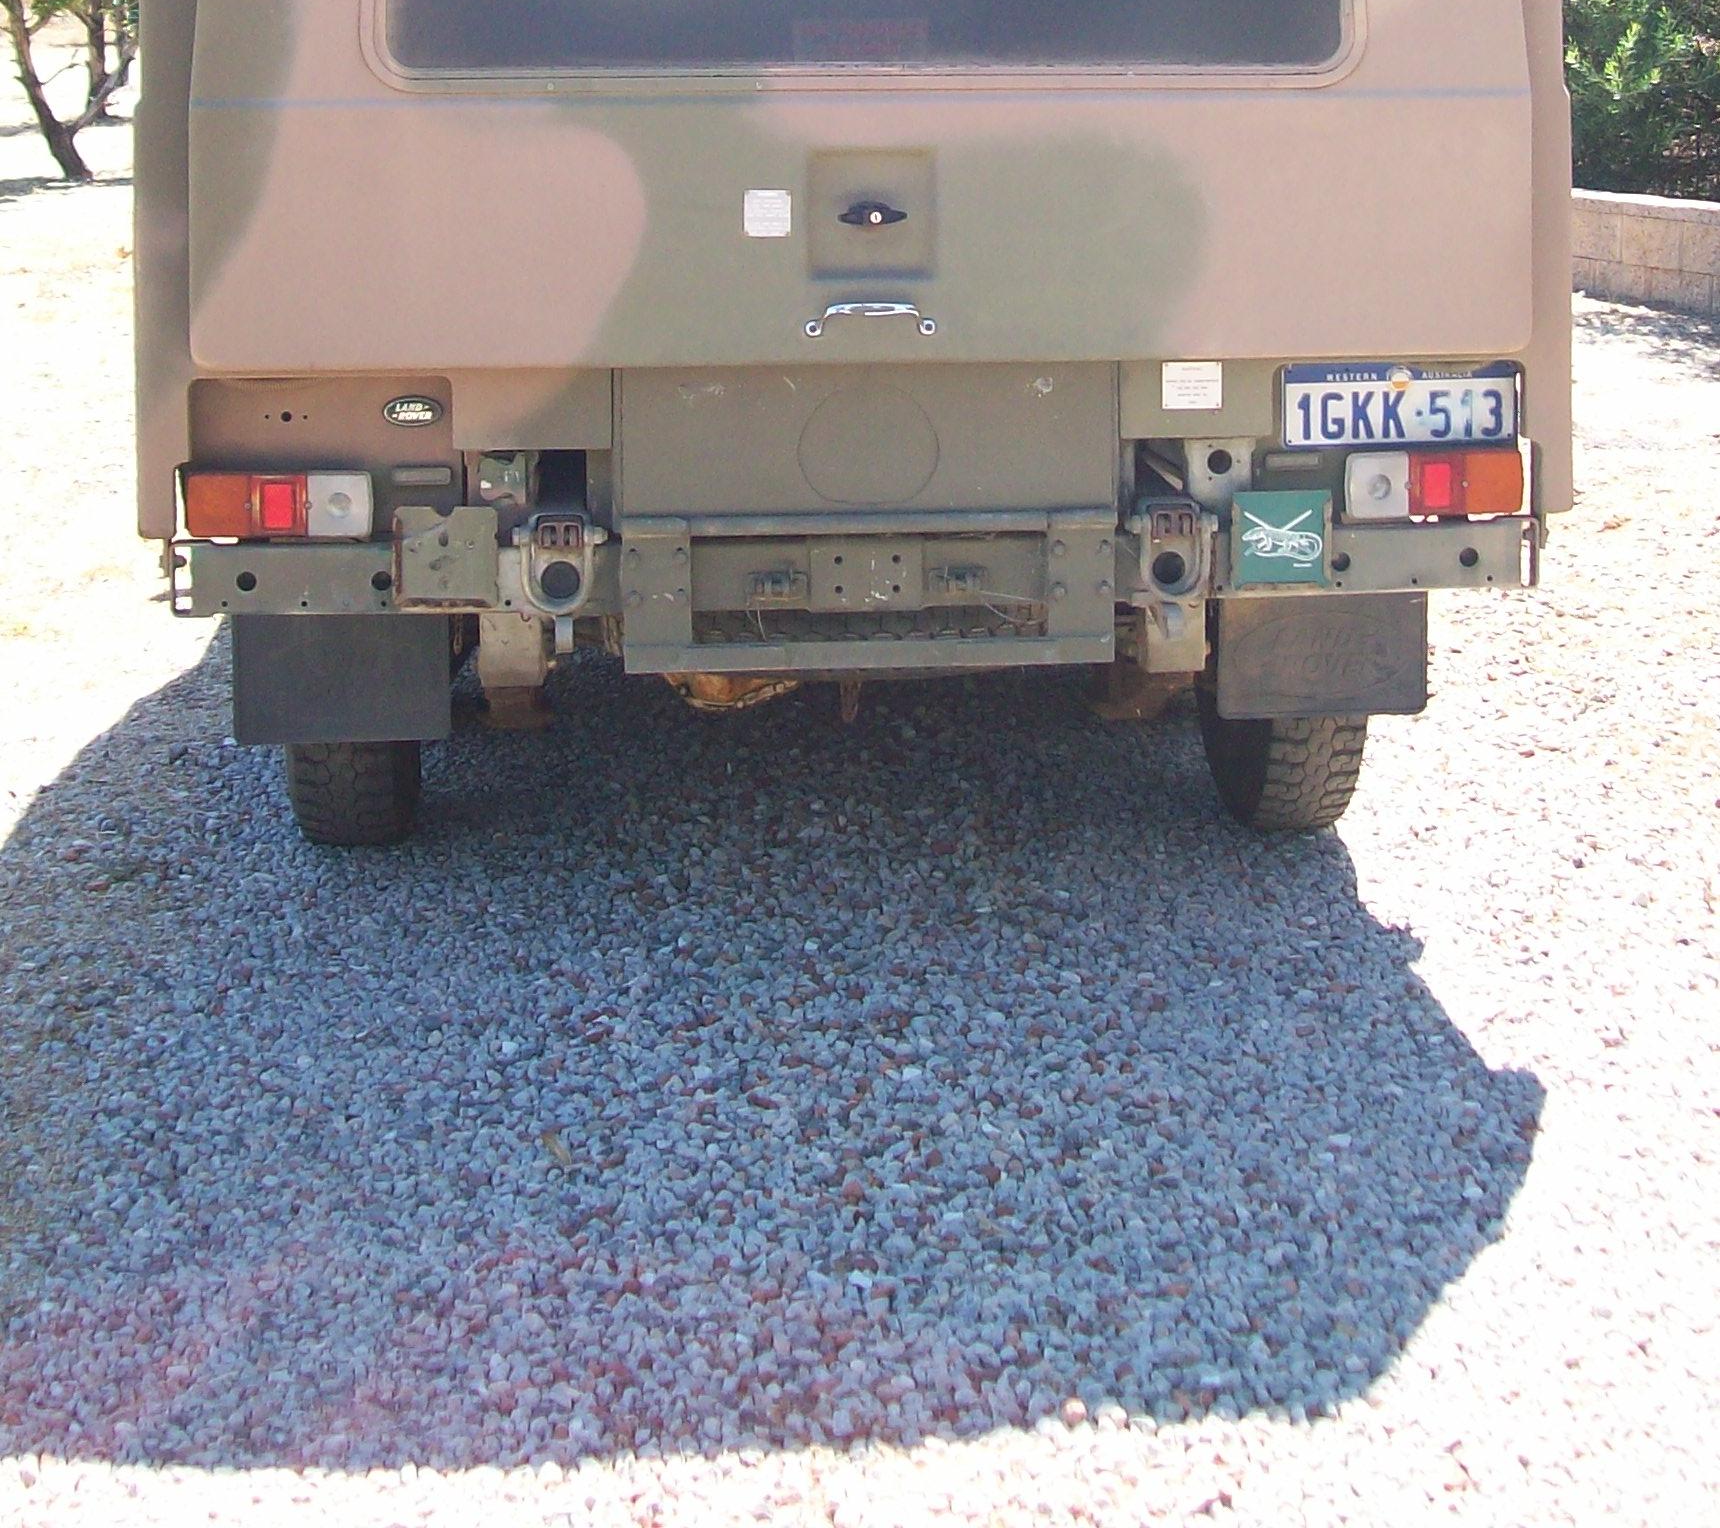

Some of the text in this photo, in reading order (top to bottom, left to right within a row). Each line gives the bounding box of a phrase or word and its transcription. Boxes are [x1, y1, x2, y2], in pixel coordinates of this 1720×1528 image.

[1326, 372, 1378, 381] WESTERN
[395, 403, 423, 412] LAND
[397, 411, 433, 420] ROVER
